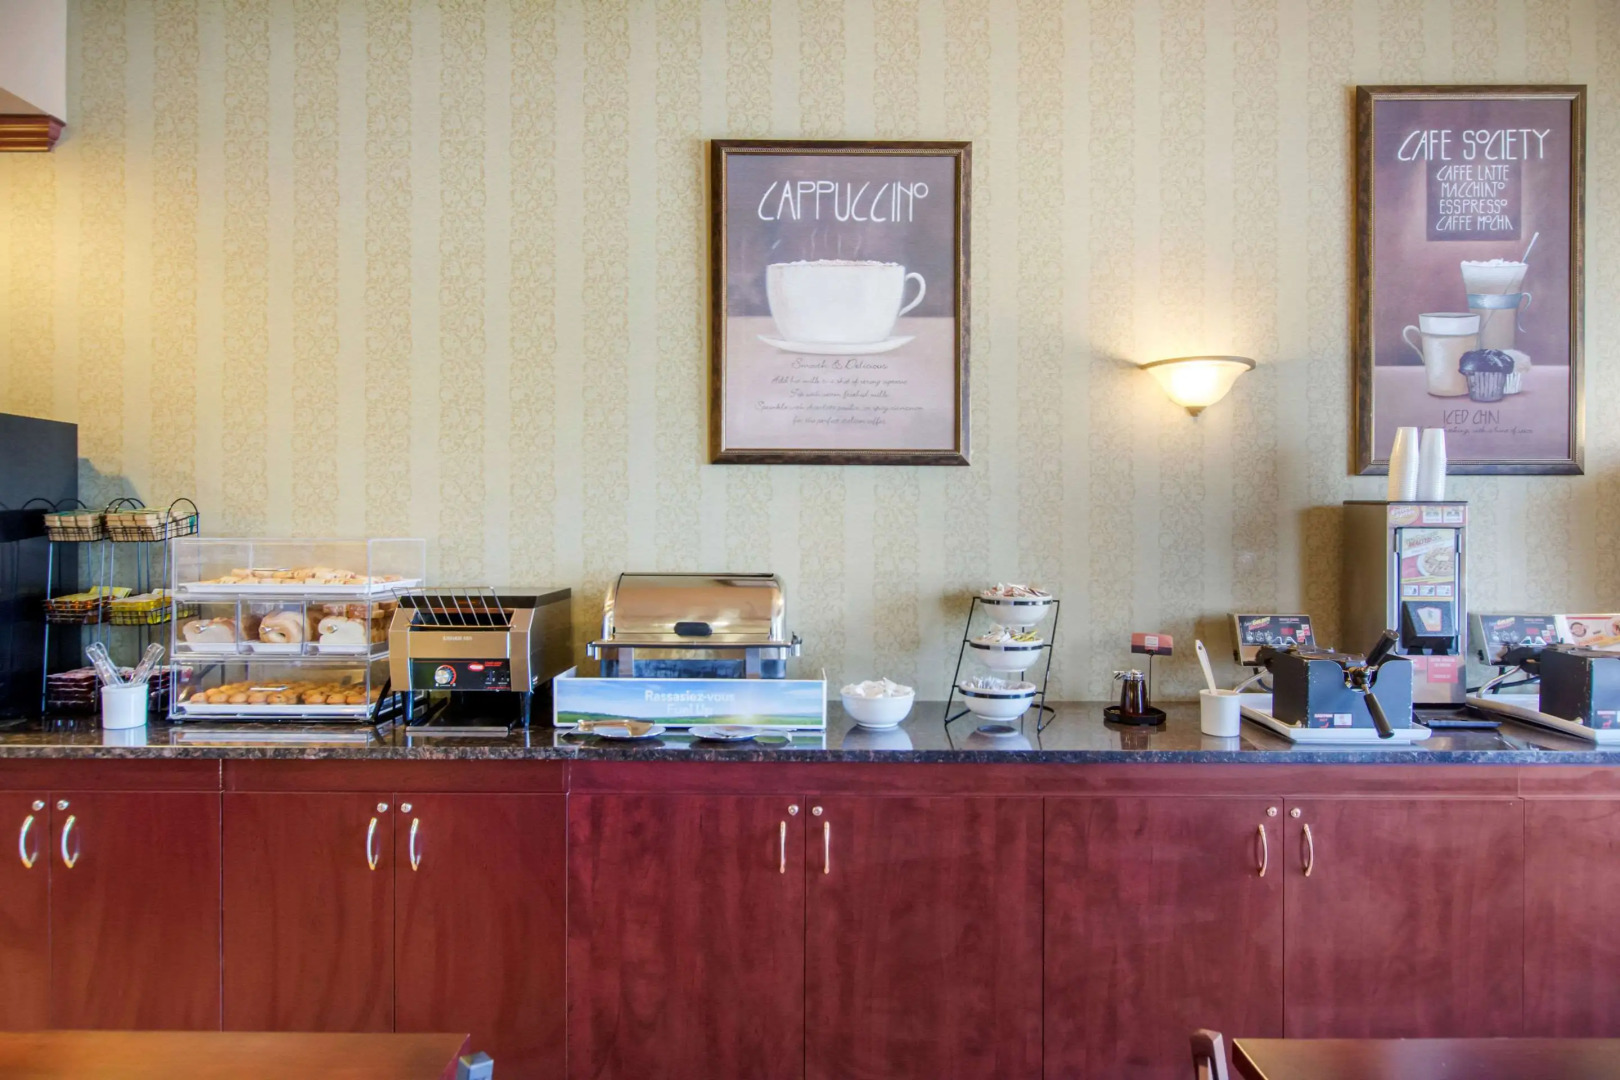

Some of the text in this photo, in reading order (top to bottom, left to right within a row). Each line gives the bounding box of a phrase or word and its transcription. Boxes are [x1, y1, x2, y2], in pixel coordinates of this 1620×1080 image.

[1398, 128, 1551, 161] CAFE SOCIETY
[1436, 164, 1510, 181] CAFFE LATTE
[757, 180, 929, 223] CAPPUCCINO
[1439, 199, 1508, 215] ESSPRESSO
[1436, 215, 1514, 231] CAFFE MOCHA
[1443, 409, 1470, 424] ICED
[644, 689, 736, 703] Rassasiez-vous
